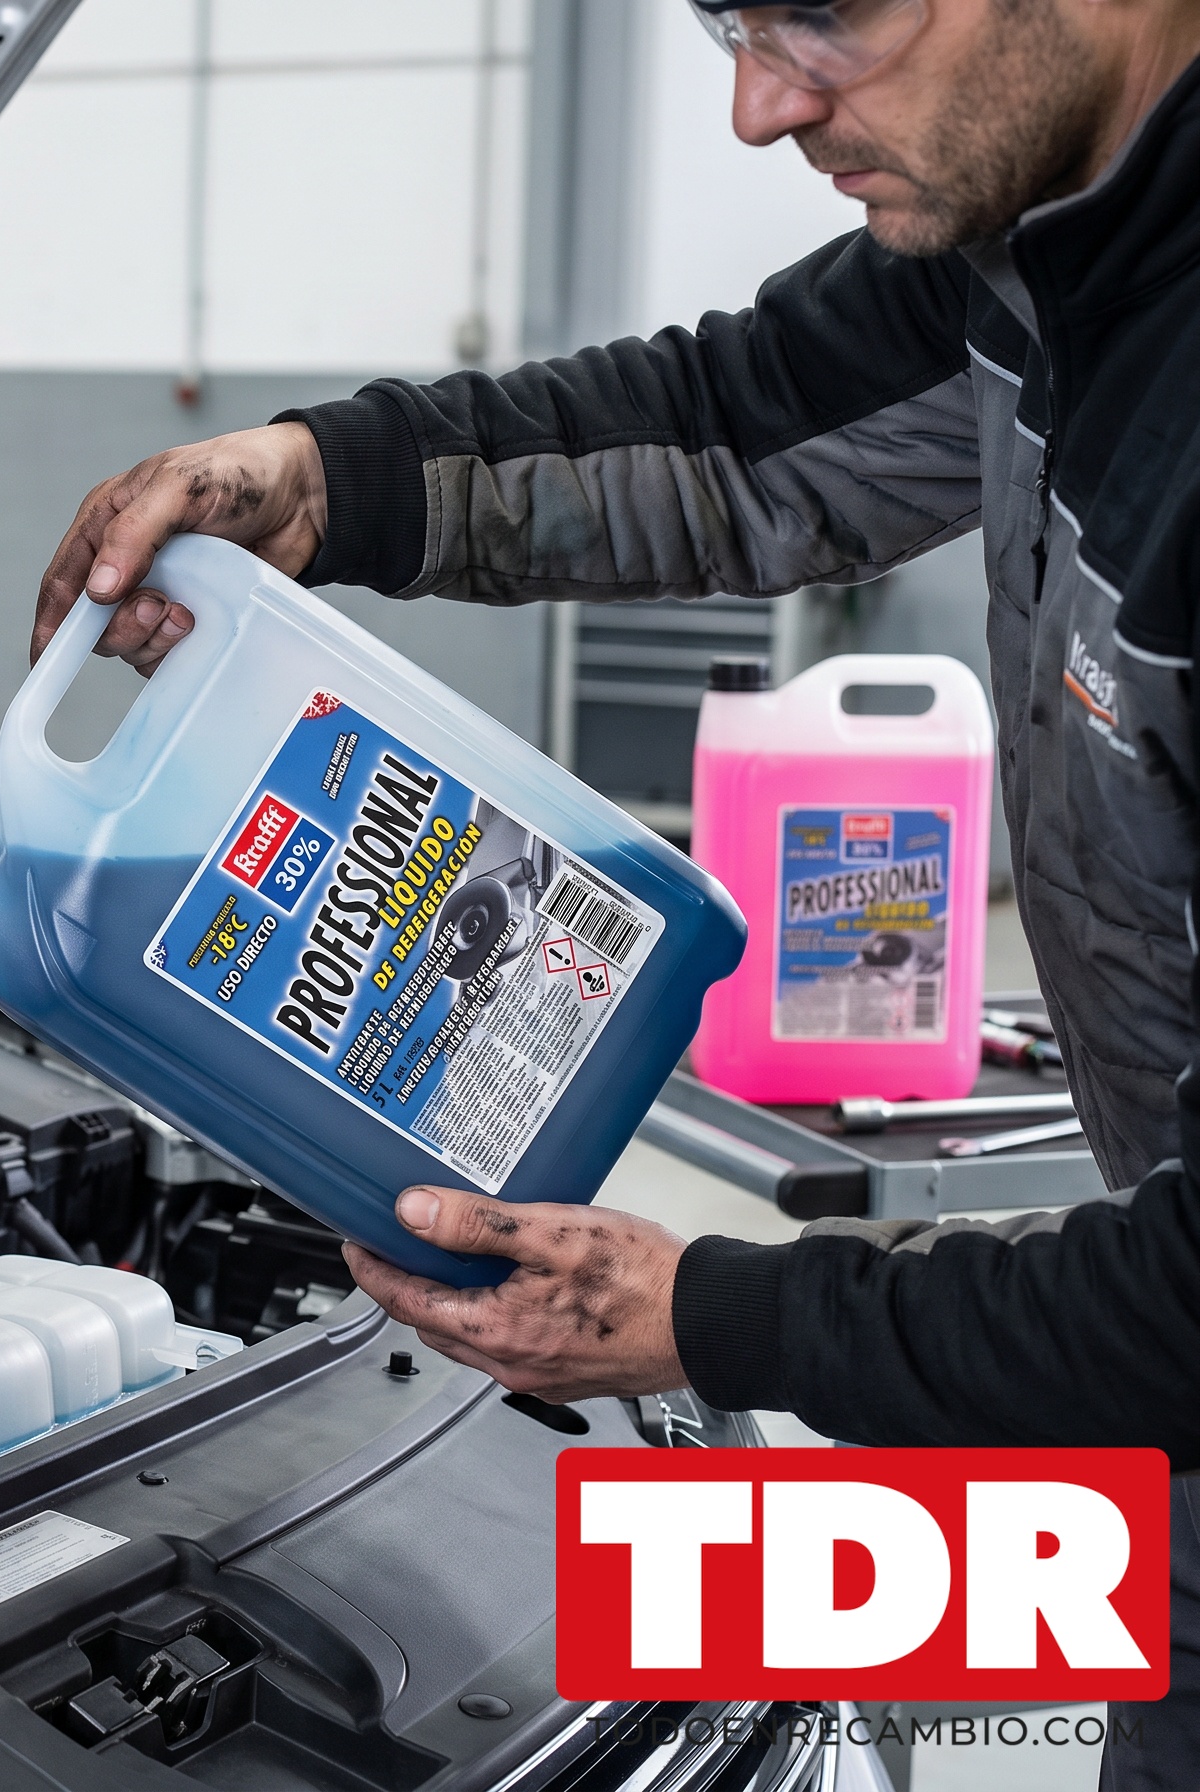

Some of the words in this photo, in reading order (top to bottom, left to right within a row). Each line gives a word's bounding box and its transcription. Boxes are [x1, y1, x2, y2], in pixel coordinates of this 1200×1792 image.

[275, 837, 320, 892] 30%
[377, 817, 454, 929] LIQUIDO
[789, 858, 941, 918] PROFESSIONAL
[276, 755, 439, 1054] PROFESSIONAL
[217, 970, 242, 1001] USO
[236, 915, 277, 971] DIRECTO
[373, 961, 396, 990] DE
[371, 1091, 386, 1109] 5
